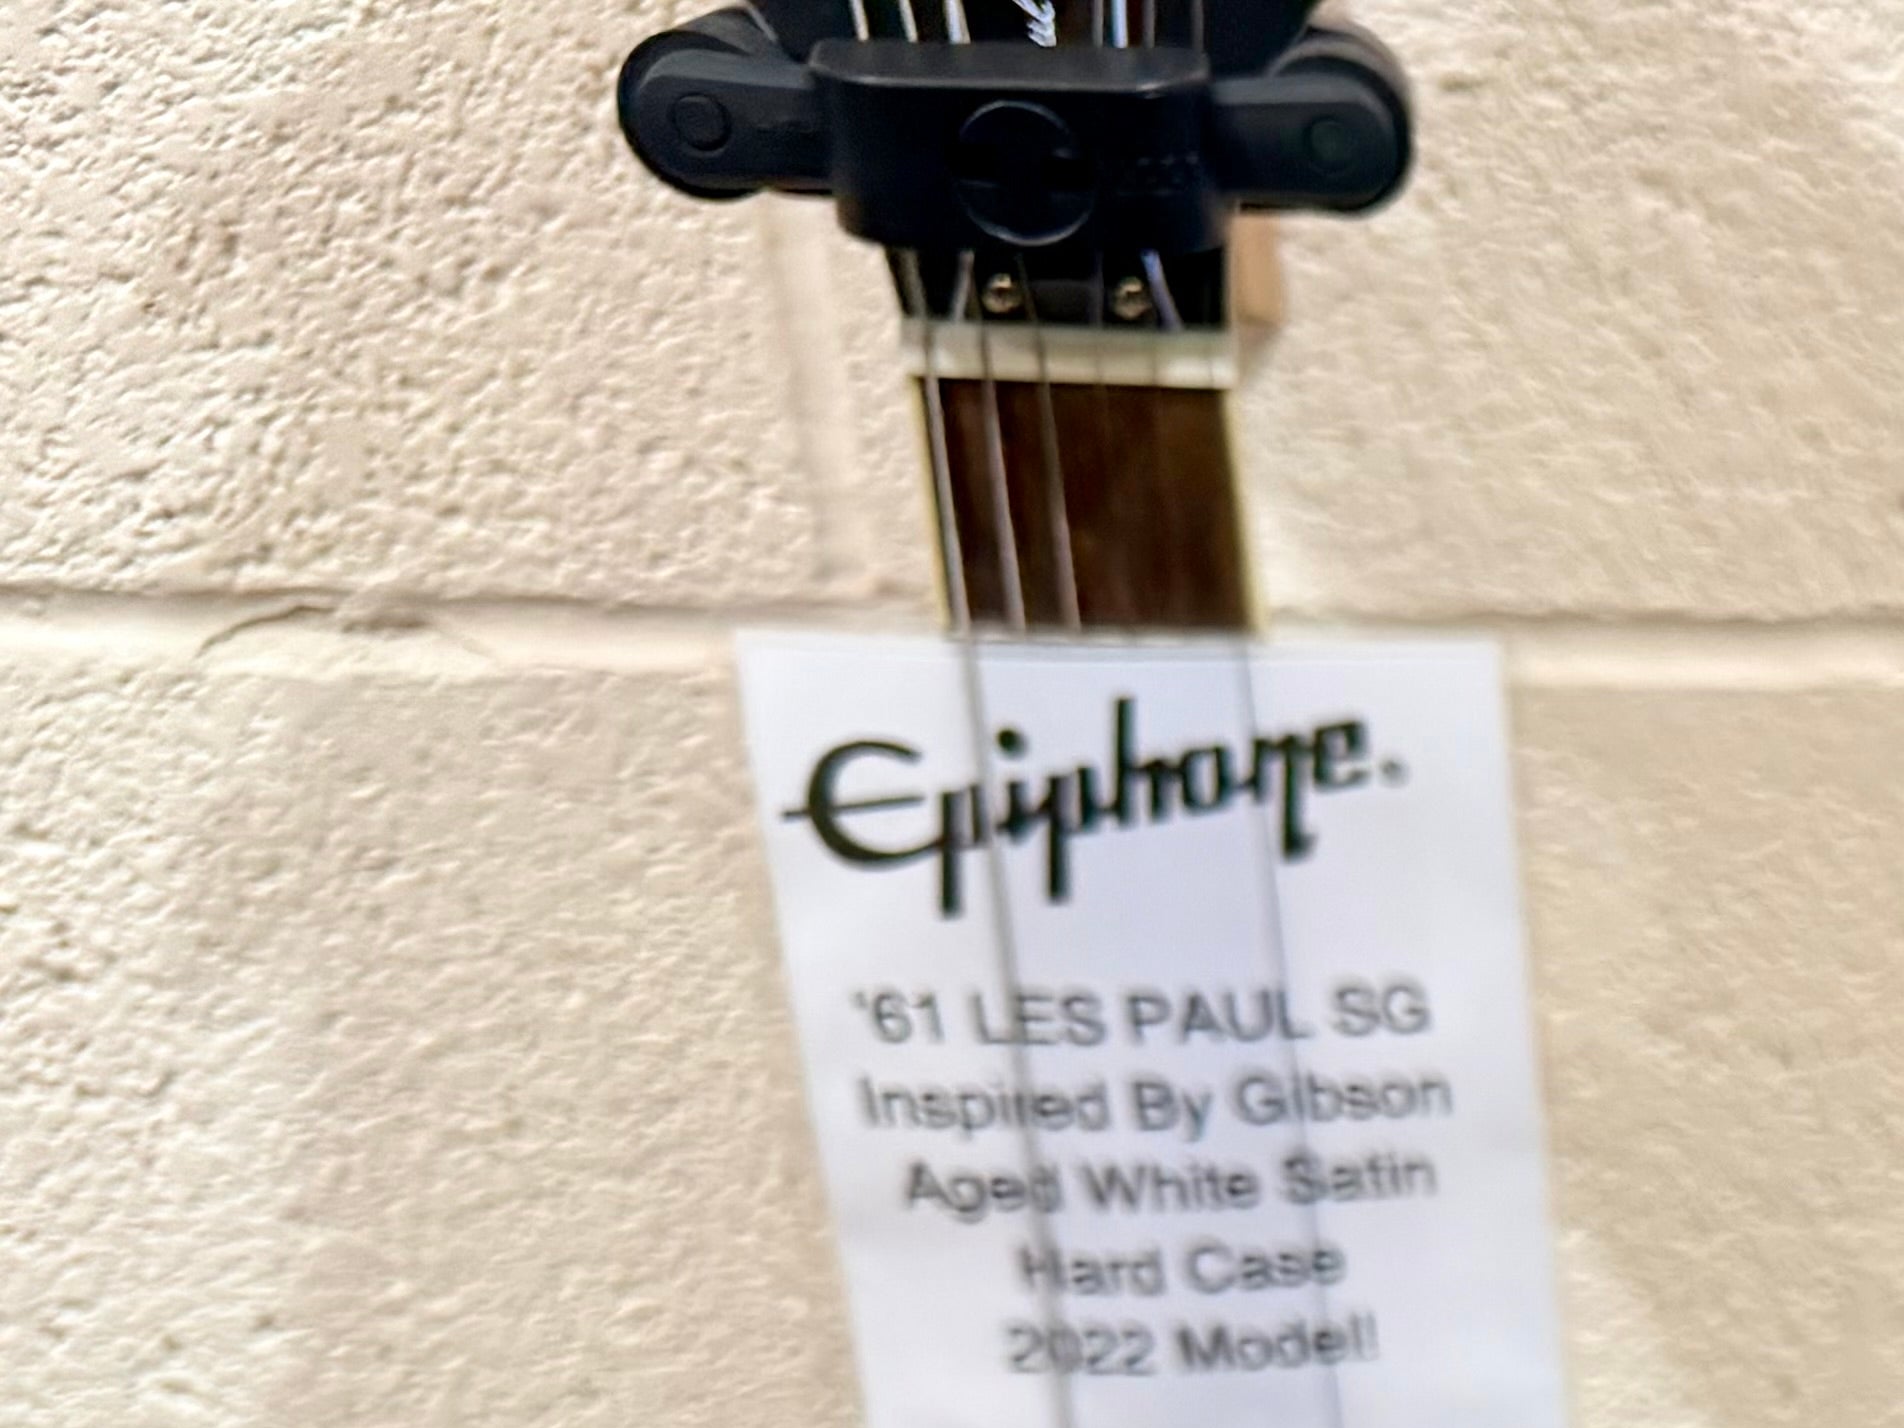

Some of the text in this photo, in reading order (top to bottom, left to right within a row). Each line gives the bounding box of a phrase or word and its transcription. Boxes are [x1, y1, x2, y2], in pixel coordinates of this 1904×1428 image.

[973, 990, 1106, 1049] LES
[1128, 986, 1314, 1047] PAUL
[1331, 977, 1433, 1038] SG
[859, 1069, 1454, 1143] Inspired By Gibson
[905, 1147, 1439, 1225] Aged White Satin
[1016, 1238, 1347, 1300] Hard Case
[1004, 1320, 1157, 1377] 2022
